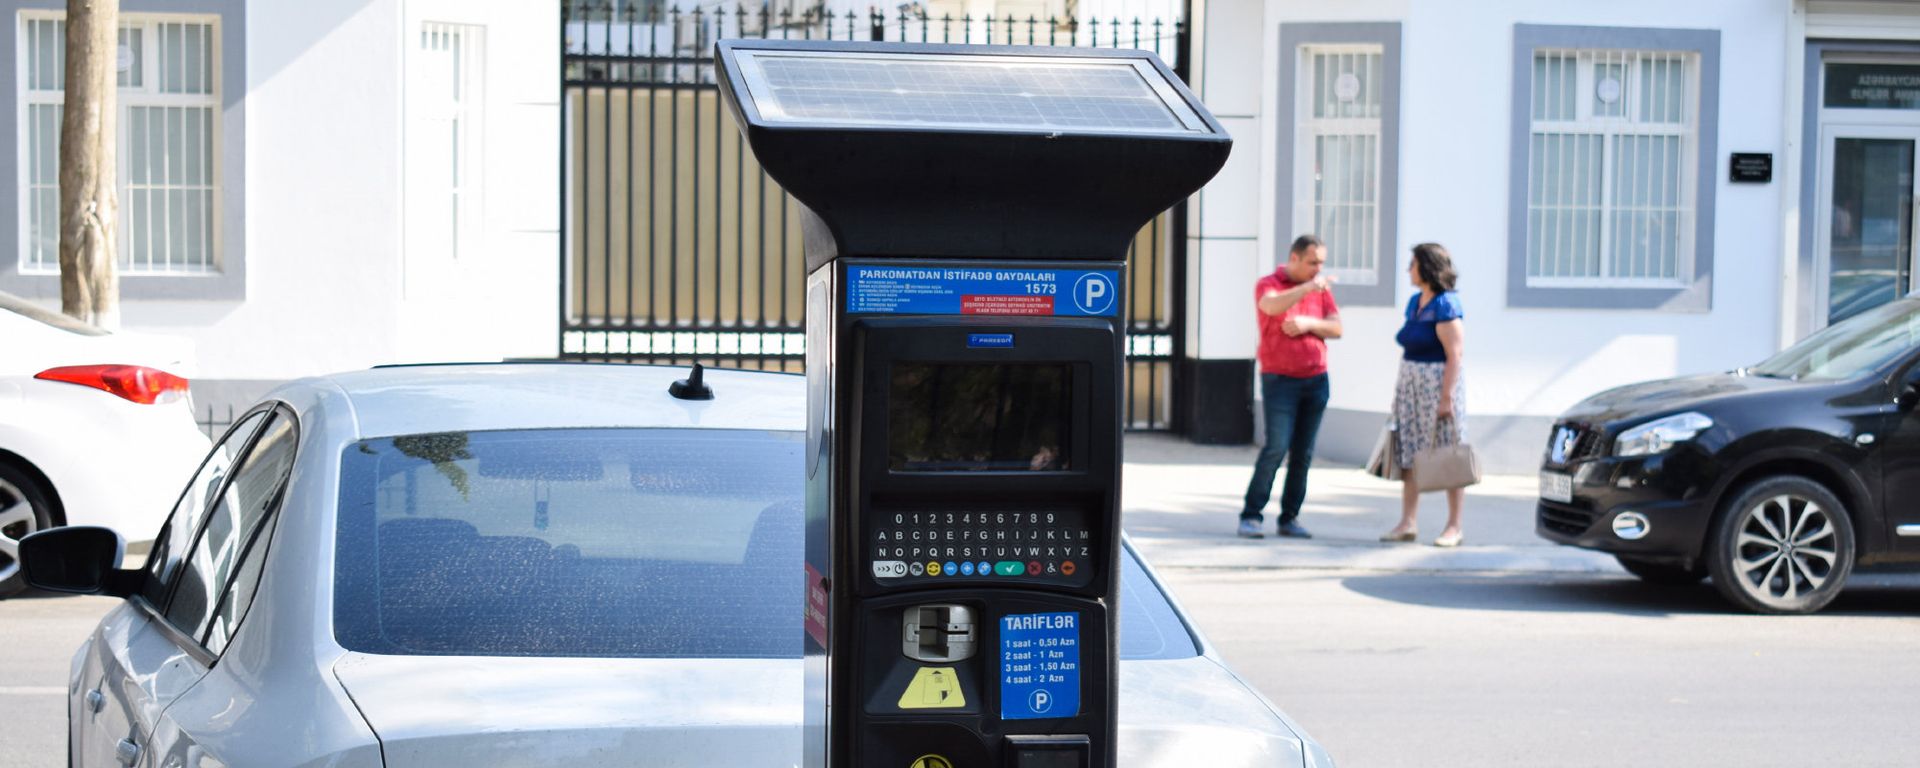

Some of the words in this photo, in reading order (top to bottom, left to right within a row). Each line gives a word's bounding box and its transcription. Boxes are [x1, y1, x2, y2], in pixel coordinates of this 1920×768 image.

[860, 270, 940, 280] PARKOMATDAN
[943, 269, 993, 280] İSTİFADƏ
[995, 272, 1056, 282] QAYDALARI
[1025, 283, 1057, 294] 1573
[1085, 279, 1106, 308] P
[896, 514, 902, 523] 0
[914, 514, 918, 523] 1
[930, 514, 936, 523] 2
[947, 514, 953, 523] 3
[964, 514, 969, 523] 4
[981, 514, 986, 523] 5
[997, 514, 1003, 523] 6
[1014, 514, 1020, 523] 7
[1031, 514, 1037, 523] 8
[1047, 514, 1053, 523] 9
[980, 531, 987, 539] G
[1016, 531, 1018, 539] I
[1031, 531, 1036, 539] J
[1048, 531, 1054, 539] K
[1065, 531, 1070, 539] L
[896, 548, 903, 556] O
[914, 548, 920, 556] P
[930, 548, 937, 556] Q
[947, 548, 953, 556] R
[964, 548, 970, 556] S
[981, 548, 987, 556] T
[998, 548, 1004, 556] U
[1082, 547, 1087, 555] Z
[1005, 614, 1074, 630] TARİFLƏR
[1005, 640, 1010, 648] 1
[1013, 640, 1031, 648] saat
[1060, 638, 1075, 646] Azn
[1005, 652, 1011, 660] 2
[1013, 652, 1031, 660] saat
[1048, 650, 1064, 658] Azn
[1006, 664, 1011, 672] 3
[1013, 663, 1031, 672] saat
[1060, 662, 1075, 670] Azn
[1006, 676, 1011, 684] 4
[1014, 676, 1031, 684] saat
[1040, 674, 1045, 682] 2
[1049, 674, 1064, 682] Azn
[1036, 693, 1047, 709] P
